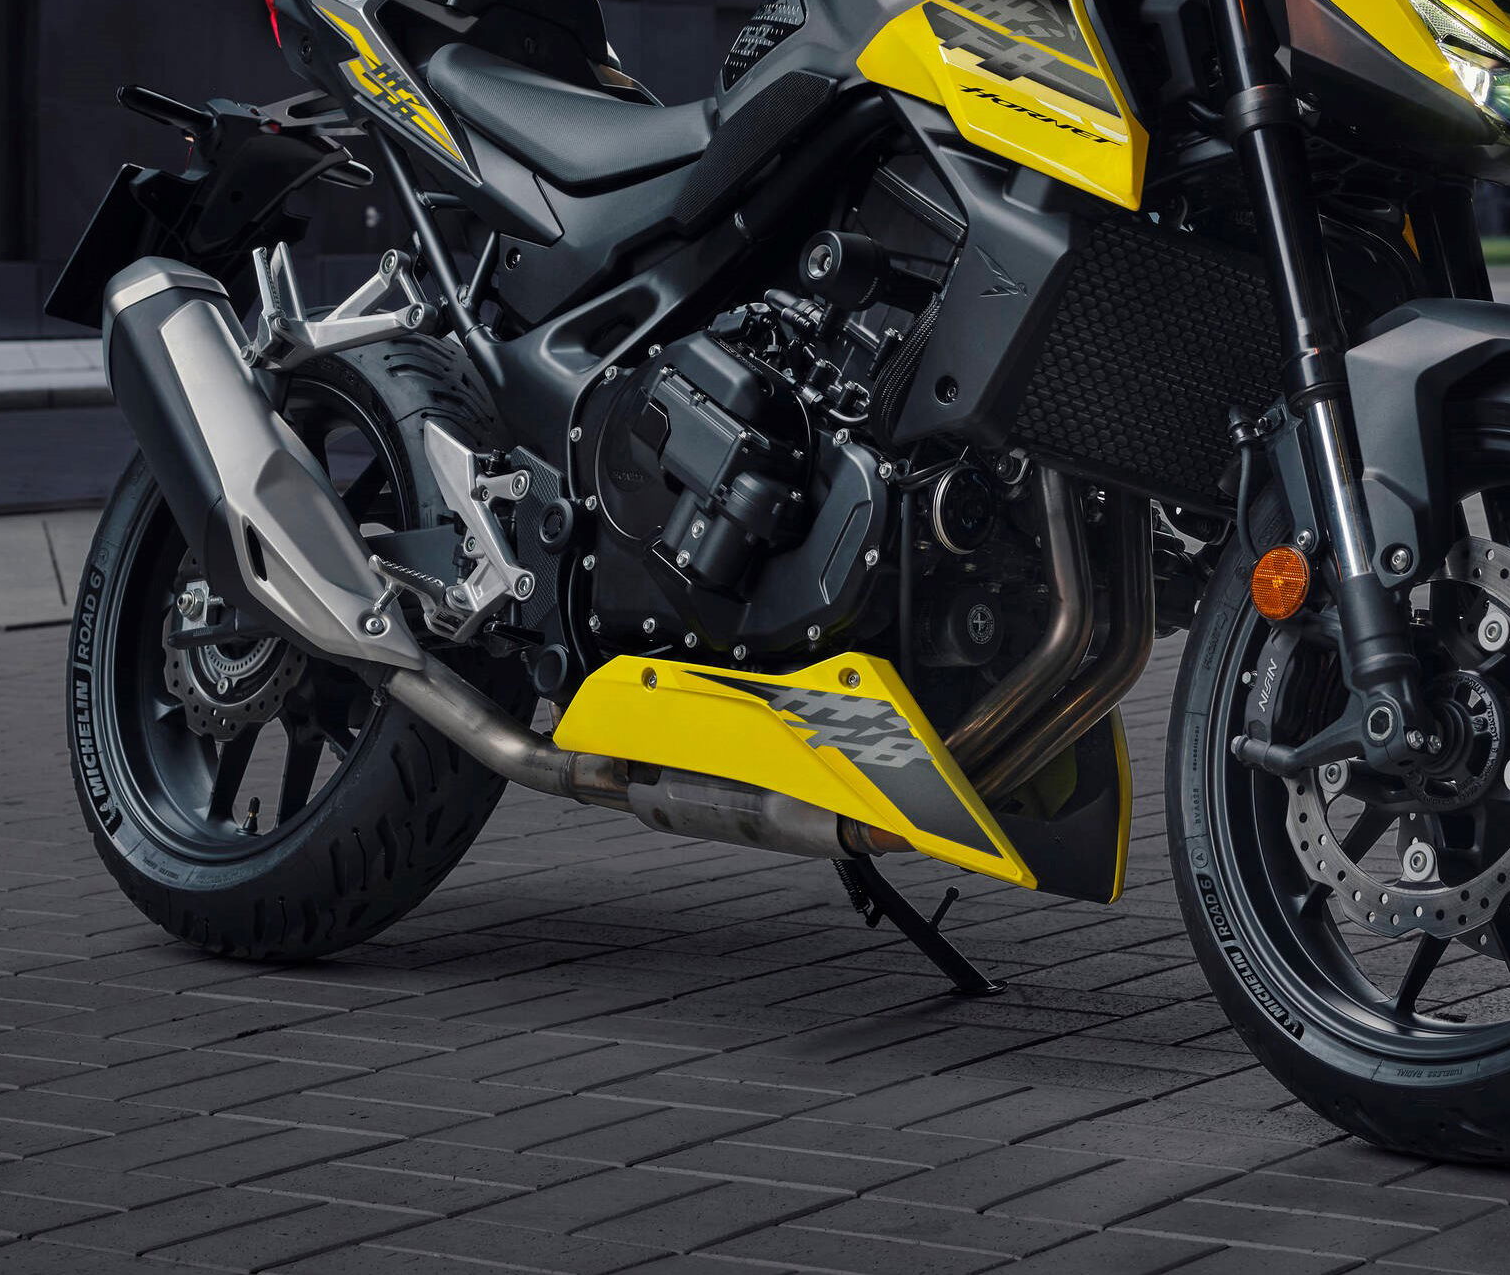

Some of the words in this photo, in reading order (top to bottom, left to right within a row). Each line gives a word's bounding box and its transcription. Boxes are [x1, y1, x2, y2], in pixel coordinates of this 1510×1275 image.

[959, 84, 1123, 146] HORNET
[90, 571, 101, 589] 6
[77, 593, 97, 660] ROAD
[1258, 657, 1278, 713] NISSIN
[76, 680, 107, 798] MICHELIN
[1200, 878, 1214, 889] 6
[1204, 894, 1232, 938] ROAD
[1232, 951, 1288, 1018] MICHELIN
